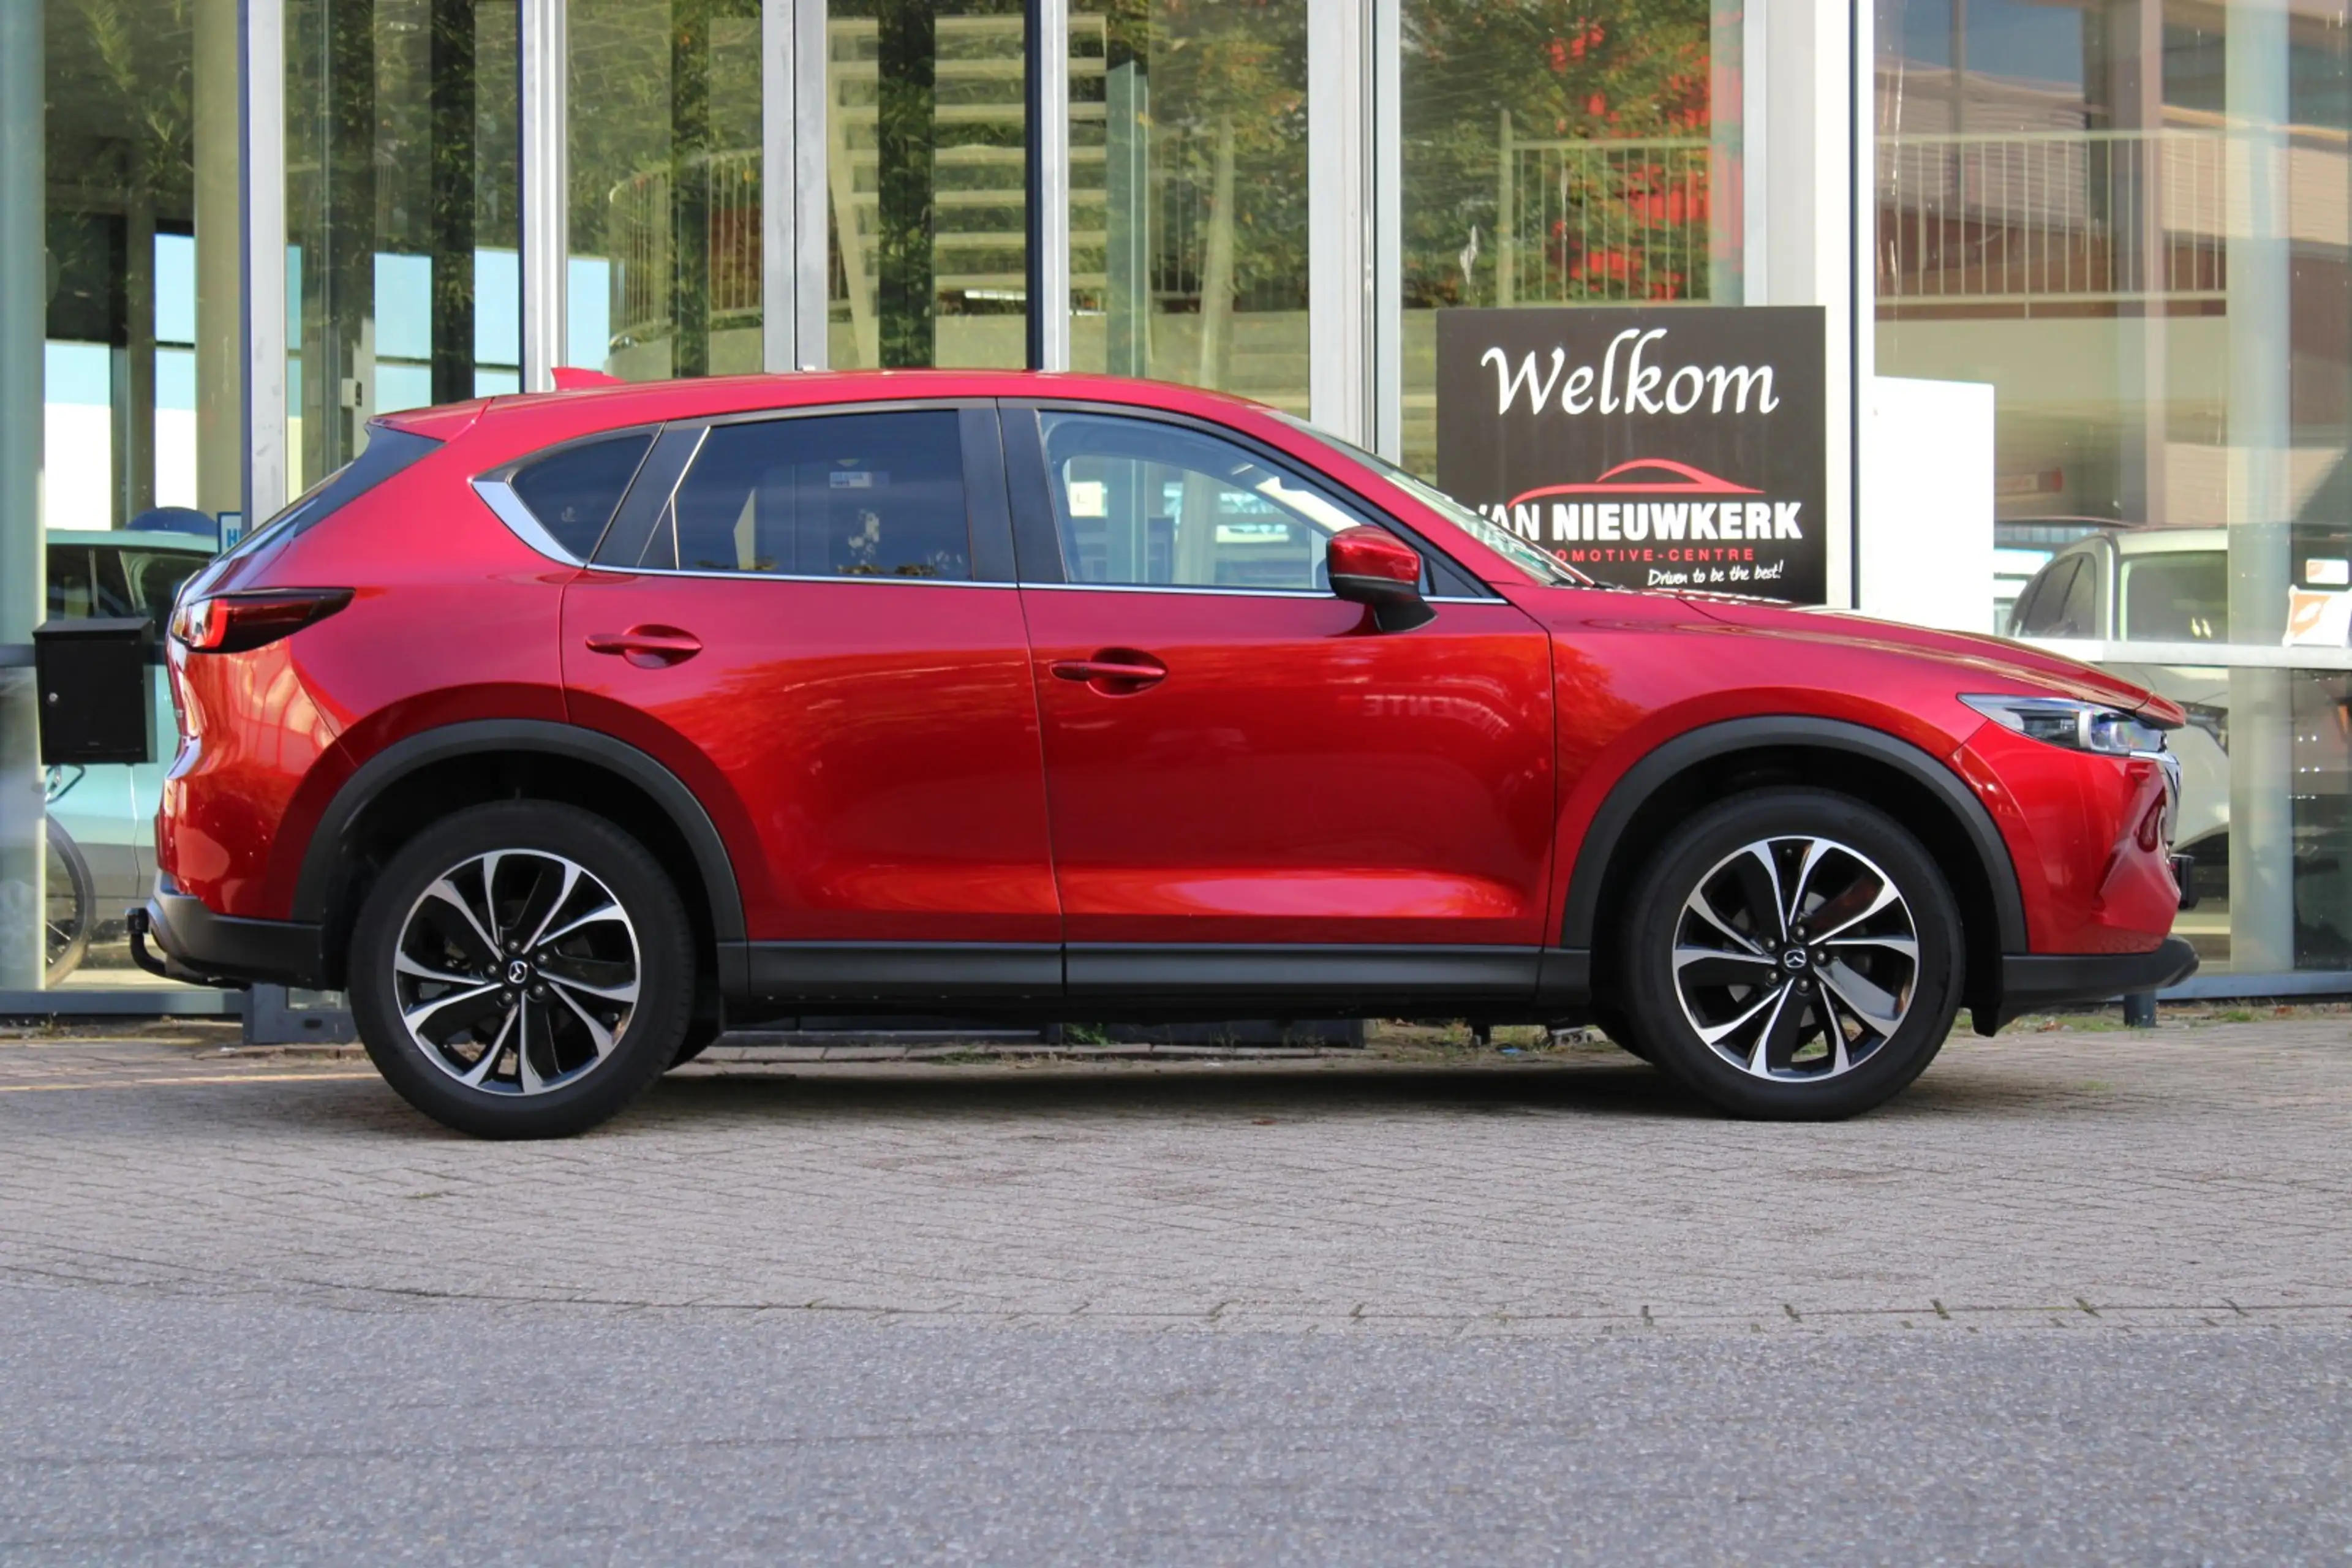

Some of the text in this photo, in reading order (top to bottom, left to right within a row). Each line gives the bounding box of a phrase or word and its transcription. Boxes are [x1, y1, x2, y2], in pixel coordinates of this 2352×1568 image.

[1480, 328, 1779, 415] Welkom
[1478, 502, 1803, 541] AN NIEUWKERK
[1552, 548, 1754, 562] OMOTIVE-CENTRE
[1647, 559, 1784, 586] Driven to be the best!
